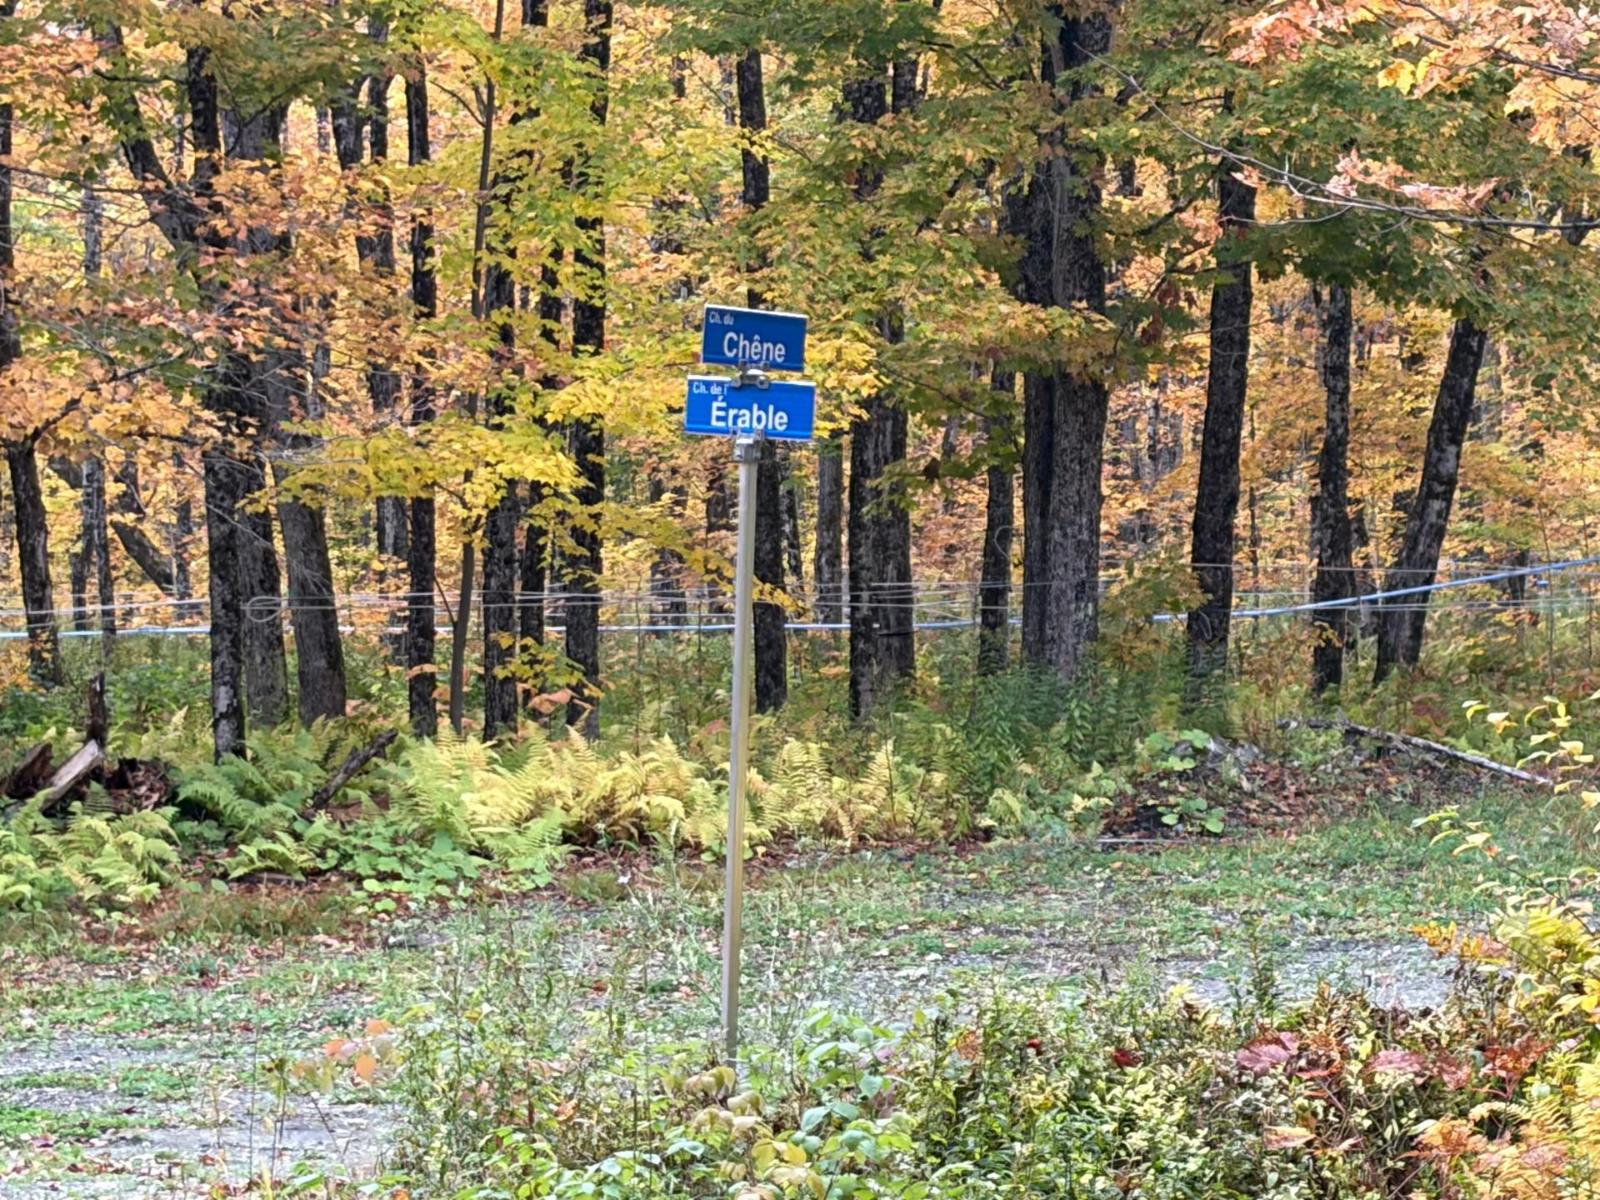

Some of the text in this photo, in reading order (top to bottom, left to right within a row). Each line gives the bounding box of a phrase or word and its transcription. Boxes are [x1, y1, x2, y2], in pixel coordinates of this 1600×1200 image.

[709, 312, 734, 325] Ch. du
[724, 332, 786, 363] Chêne
[692, 382, 708, 394] Ch.
[710, 383, 722, 395] de
[711, 396, 788, 431] Érable
